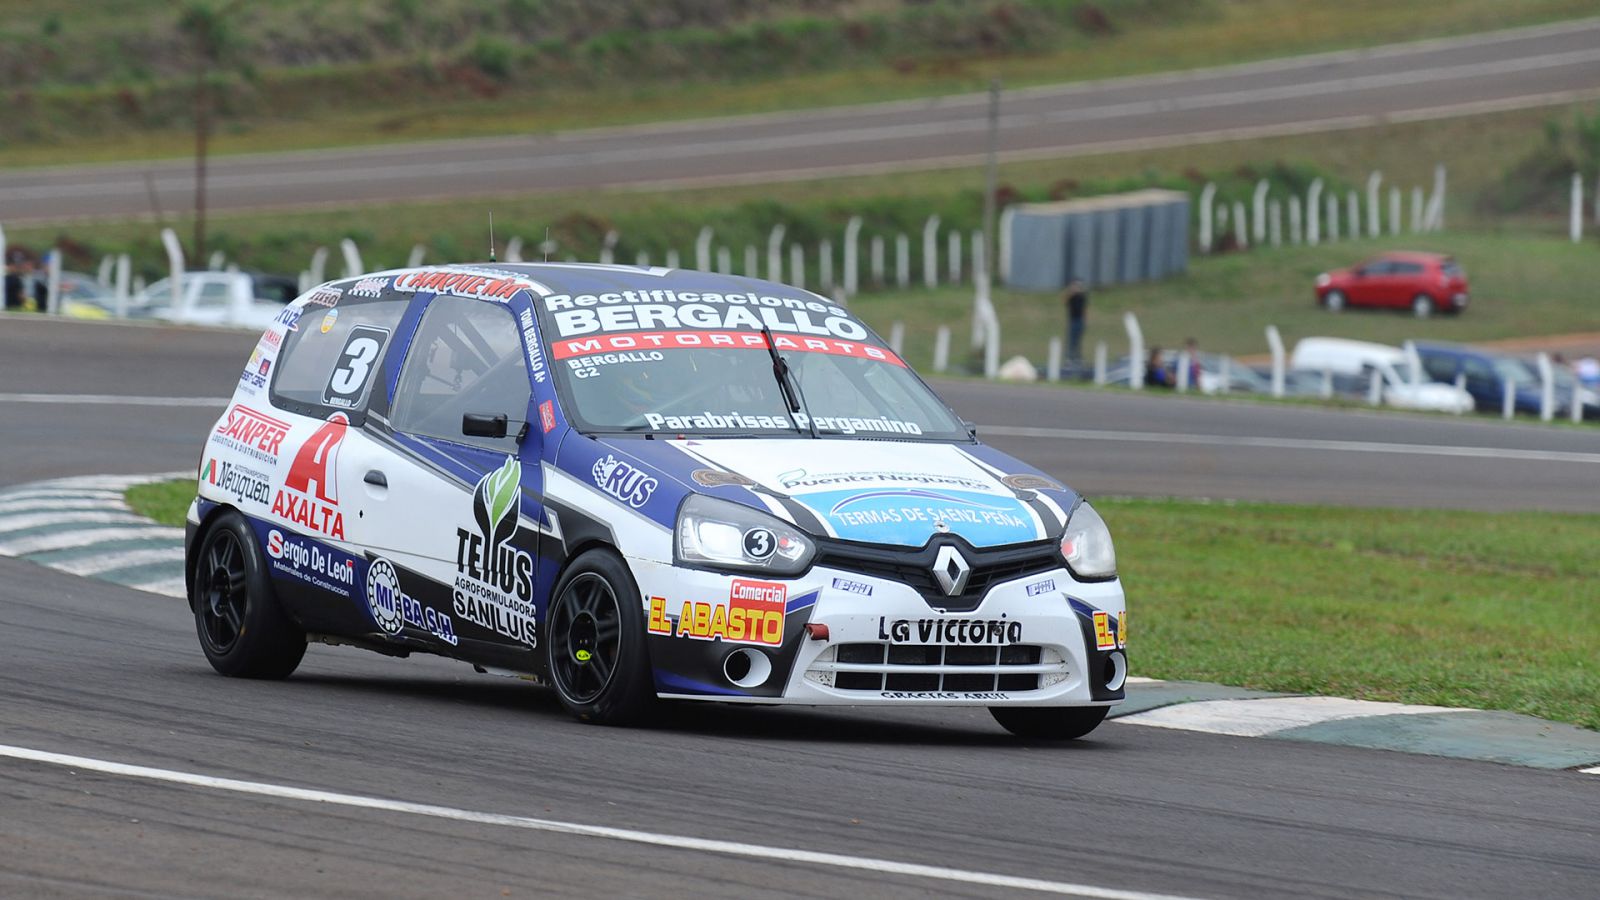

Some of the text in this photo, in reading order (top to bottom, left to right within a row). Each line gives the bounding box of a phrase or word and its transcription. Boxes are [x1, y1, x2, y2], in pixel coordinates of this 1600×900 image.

[544, 290, 848, 318] Rectificaciones
[554, 303, 868, 341] BERGALLO
[524, 326, 545, 371] BERGALLO
[567, 334, 886, 359] MOTORPARTS
[567, 351, 664, 370] BERGALLO
[331, 337, 379, 394] 3
[574, 367, 600, 379] C2
[216, 404, 292, 456] SANPER
[644, 411, 922, 435] Parabrisas Pergamino
[216, 461, 270, 505] Neuquen
[604, 463, 657, 506] RUS
[271, 489, 345, 541] AXALTA
[837, 508, 902, 526] TERMAS
[901, 508, 928, 522] DE
[927, 508, 982, 524] SAENZ
[267, 529, 309, 569] Sergio
[311, 546, 325, 573] De
[751, 531, 769, 555] 3
[376, 582, 394, 613] MI
[454, 576, 536, 617] AGROFORMULADORA
[732, 582, 785, 603] Comercial
[648, 596, 783, 644] EL ABASTO
[1093, 612, 1115, 648] EL
[880, 692, 959, 700] GRACIAS
